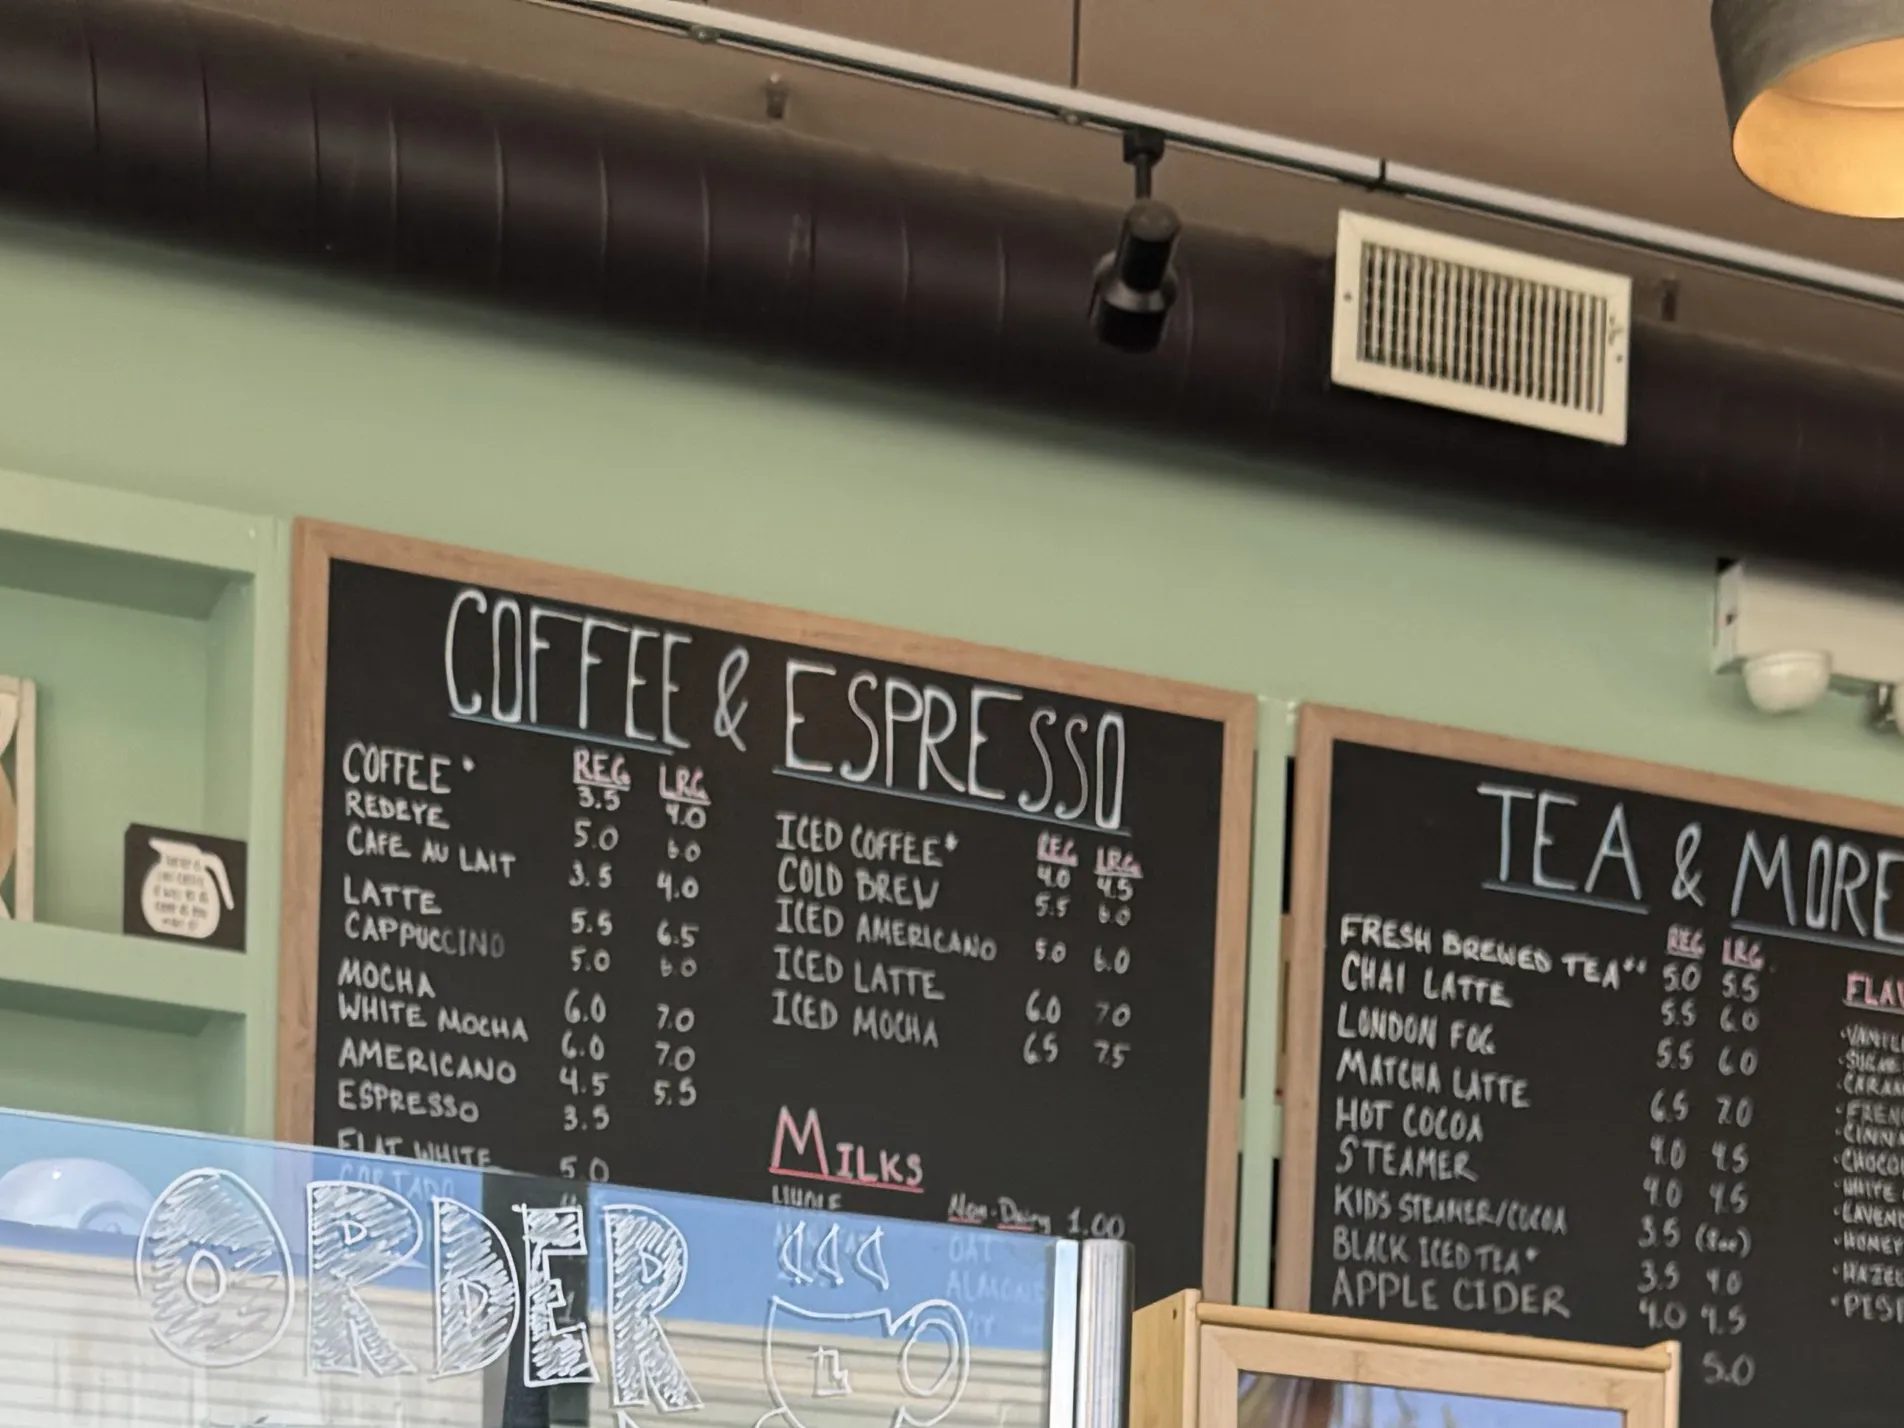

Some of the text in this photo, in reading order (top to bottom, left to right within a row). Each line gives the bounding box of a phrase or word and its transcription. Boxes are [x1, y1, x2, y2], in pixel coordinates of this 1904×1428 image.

[445, 587, 1125, 829] COFFEE & ESPRESSO
[345, 791, 450, 829] REDEYE
[574, 820, 619, 851] 5.0
[579, 785, 707, 829] 3.5 4.0
[346, 825, 699, 900] CAFE AU LAIT 3.5 4.0
[775, 810, 1134, 901] ICED 4.0 4.5
[1477, 782, 1642, 900] TEA
[1672, 822, 1705, 907] &
[343, 873, 699, 948] LATTE 5.5 6.5
[777, 855, 843, 898] COLD
[855, 867, 939, 910] BREW
[1035, 891, 1070, 918] 5.5
[344, 910, 505, 958] CAPPUCCINO
[570, 946, 611, 972] 5.0
[775, 899, 1131, 974] ICED AMERICANO 5.0 6.0
[1340, 913, 1432, 954] FRESH
[1442, 929, 1552, 973] BREWED
[338, 957, 696, 1033] MOCHA 6.0 7.0
[773, 944, 843, 984] ICED
[854, 959, 945, 1000] LATTE
[1342, 950, 1405, 994] CHAI
[1424, 966, 1513, 1008] LATTE
[338, 992, 696, 1071] WHITE MOCHA 6.0 7.0
[771, 989, 839, 1030] ICED
[853, 1003, 940, 1048] MOCHA
[1338, 1001, 1438, 1049] LONDON
[1451, 1020, 1495, 1054] FOG
[338, 1036, 697, 1106] AMERICANO 4.5 5.5
[1336, 1047, 1441, 1094] MATCHA
[1453, 1065, 1531, 1108] LATTE
[338, 1078, 610, 1132] ESPRESSO 3.5
[1336, 1095, 1394, 1132] HOT
[1403, 1102, 1484, 1142] COCOA
[559, 1156, 610, 1183] 5.0
[770, 1104, 925, 1190] MILKS
[1336, 1134, 1479, 1182] STEAMER
[1334, 1182, 1392, 1221] KIDS
[1843, 1177, 1895, 1203] WHITE
[1067, 1207, 1125, 1241] 1.00
[1333, 1225, 1410, 1264] BLACK
[1419, 1235, 1471, 1270] ICED
[1843, 1229, 1904, 1257] HONEY
[135, 1167, 704, 1415] ORDER
[1332, 1266, 1440, 1310] APPLE
[1452, 1276, 1571, 1319] CIDER
[1702, 1351, 1756, 1386] 5.0
